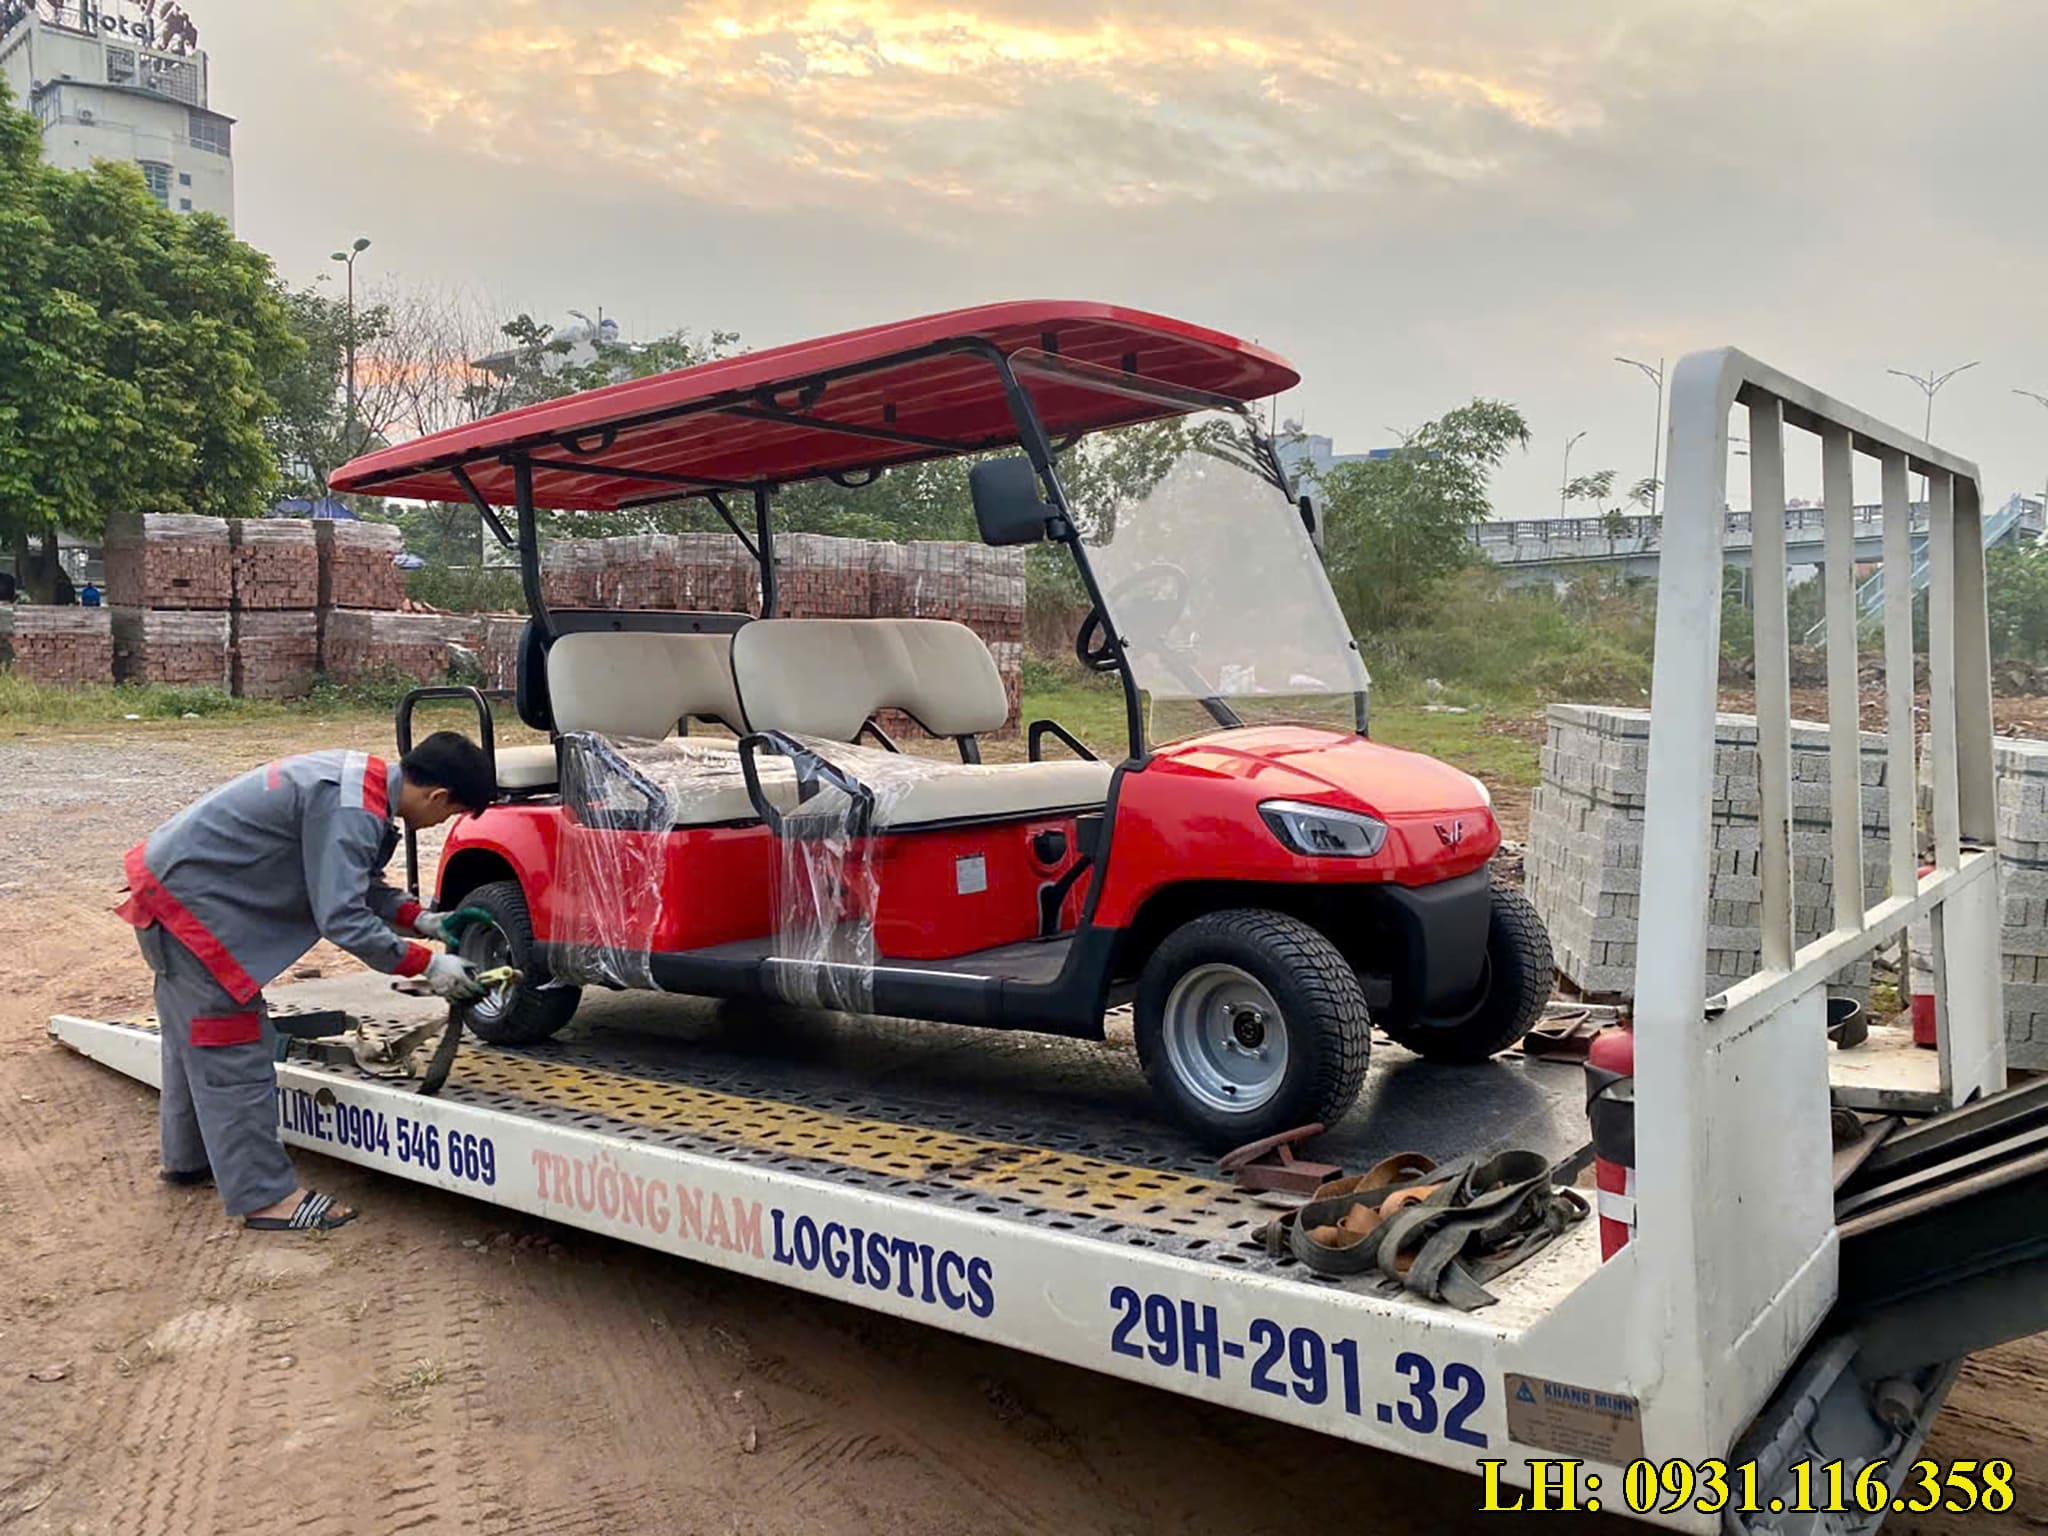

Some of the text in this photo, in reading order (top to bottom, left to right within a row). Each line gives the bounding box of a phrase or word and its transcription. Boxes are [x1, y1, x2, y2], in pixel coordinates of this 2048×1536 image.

[336, 1102, 390, 1156] 0904
[396, 1117, 441, 1171] 546
[447, 1130, 496, 1186] 669
[532, 1150, 994, 1317] TRƯỜNG NAM LOGISTICS
[1110, 1286, 1488, 1449] 29H-291.32
